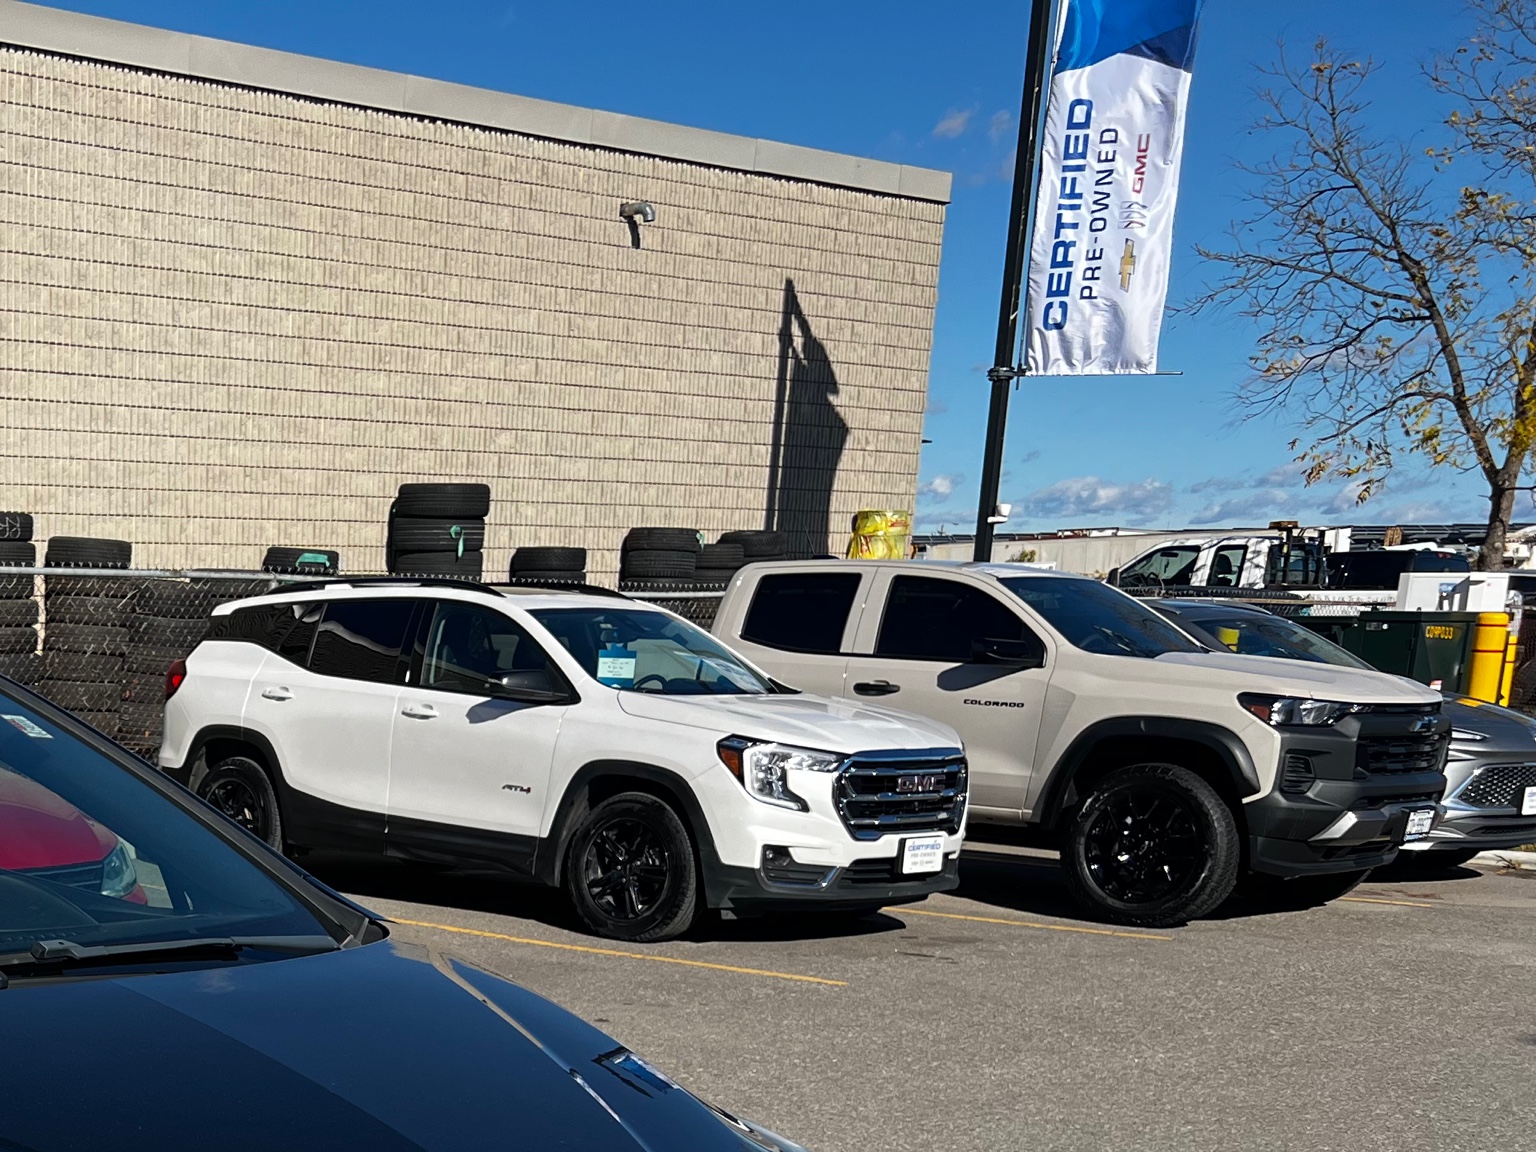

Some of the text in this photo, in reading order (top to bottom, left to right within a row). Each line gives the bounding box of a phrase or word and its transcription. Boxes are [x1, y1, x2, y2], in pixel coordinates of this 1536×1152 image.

[1132, 133, 1151, 194] GMC
[1043, 98, 1094, 332] CERTIFIED
[1080, 128, 1119, 301] PRE-OWNED
[963, 698, 1025, 708] COLORADO
[896, 774, 946, 792] GMC
[907, 843, 942, 852] CERTIFIED
